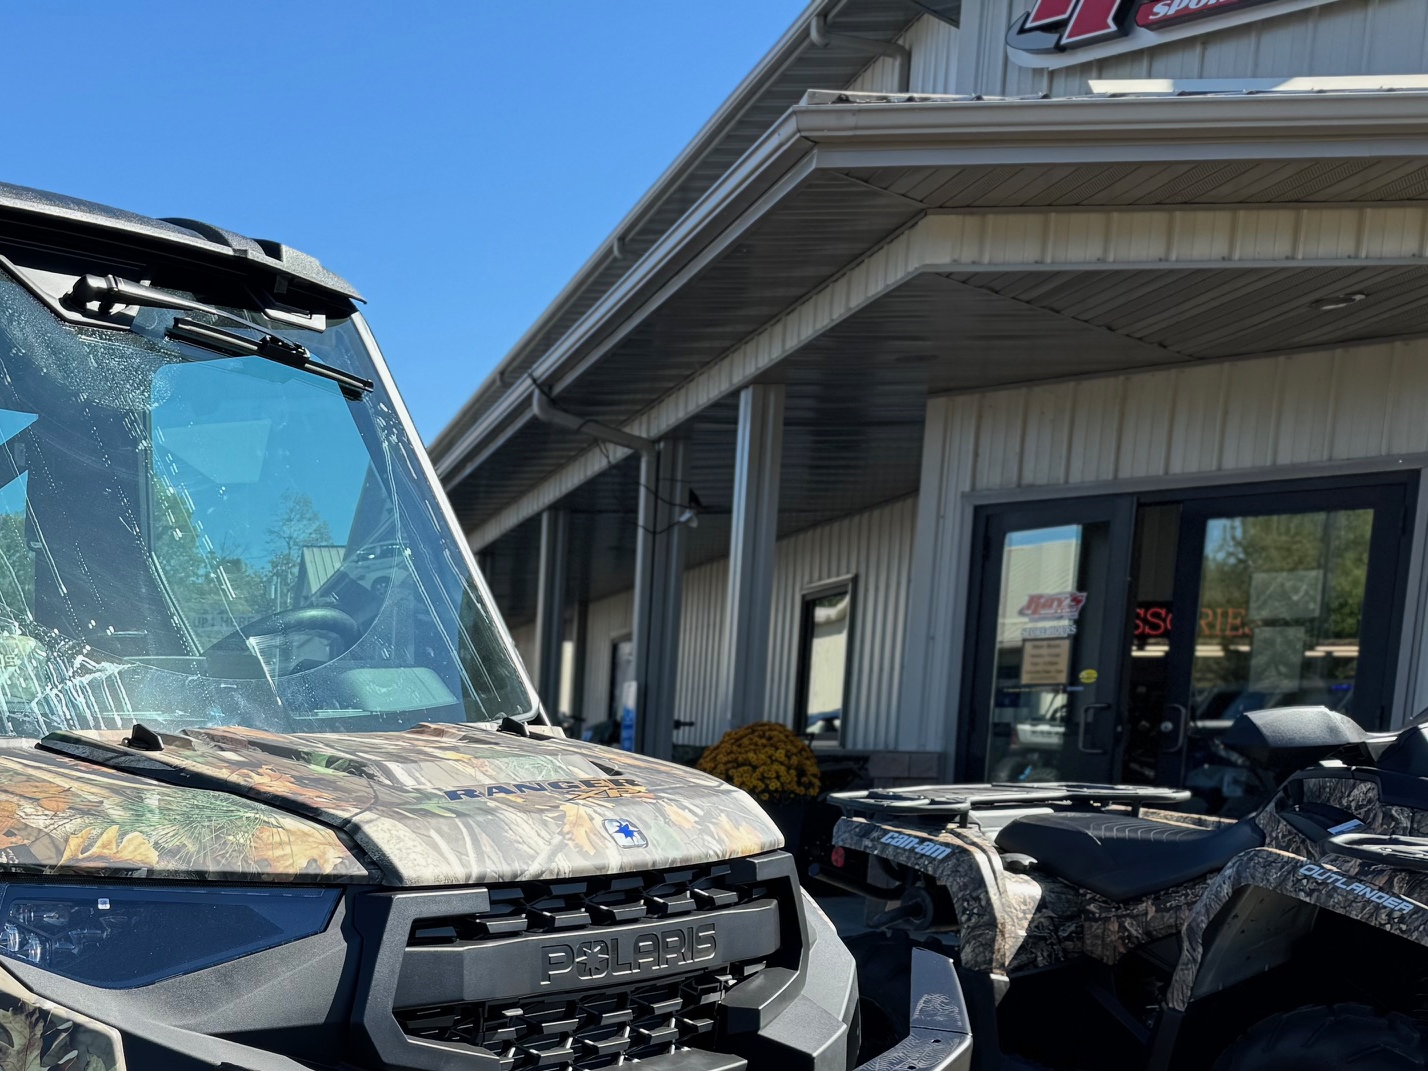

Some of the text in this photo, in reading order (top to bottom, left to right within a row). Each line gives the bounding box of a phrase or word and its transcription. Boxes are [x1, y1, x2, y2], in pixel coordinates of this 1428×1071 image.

[443, 778, 643, 802] RANGER
[880, 831, 953, 860] can-am
[1299, 864, 1415, 914] OUTLANDER
[540, 922, 717, 986] POLARIS
